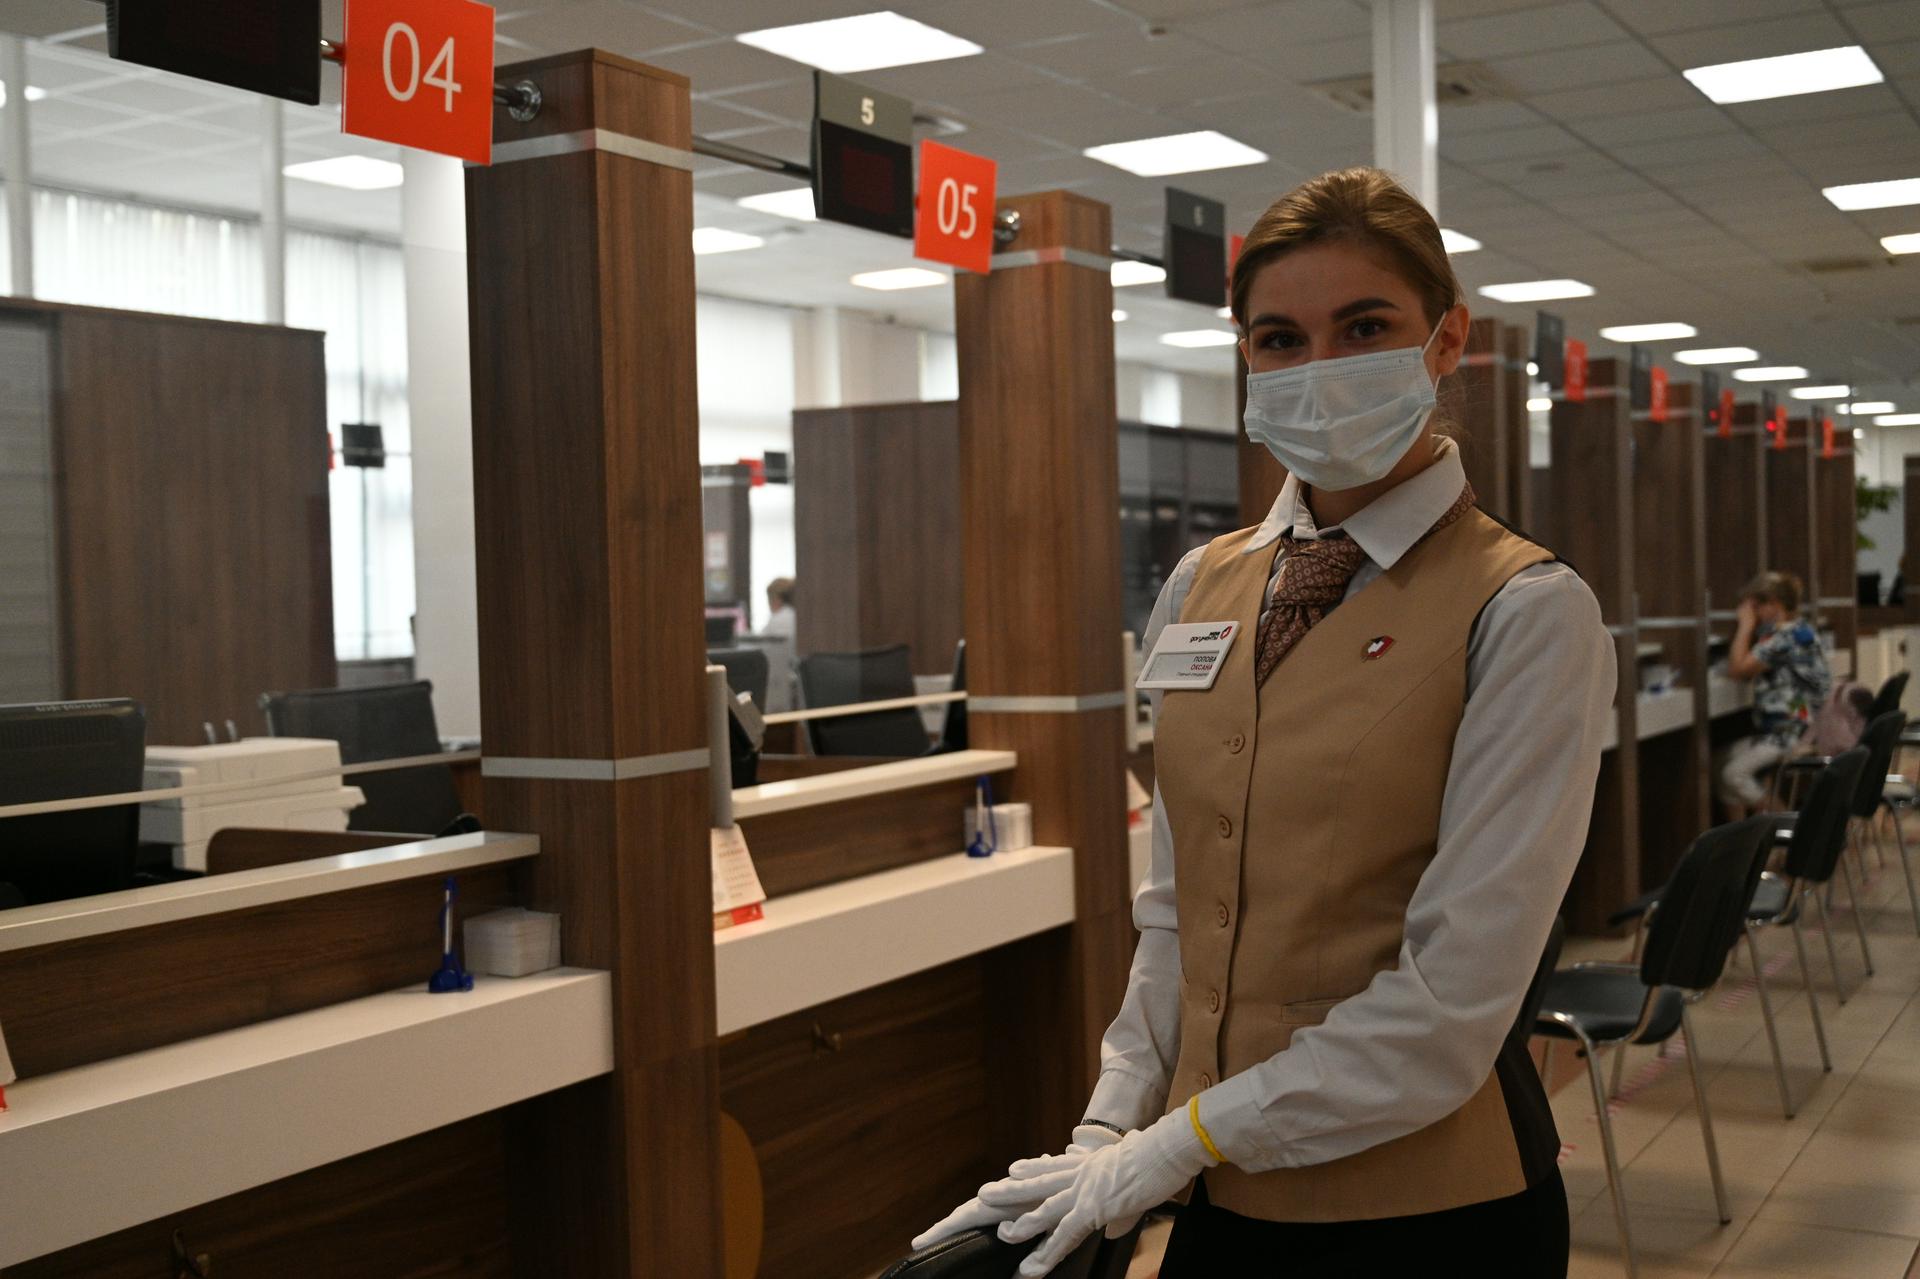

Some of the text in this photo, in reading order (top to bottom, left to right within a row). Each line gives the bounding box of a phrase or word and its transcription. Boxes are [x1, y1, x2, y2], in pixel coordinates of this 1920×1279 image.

[382, 22, 462, 113] 04
[860, 97, 875, 125] 5
[937, 178, 978, 240] 05
